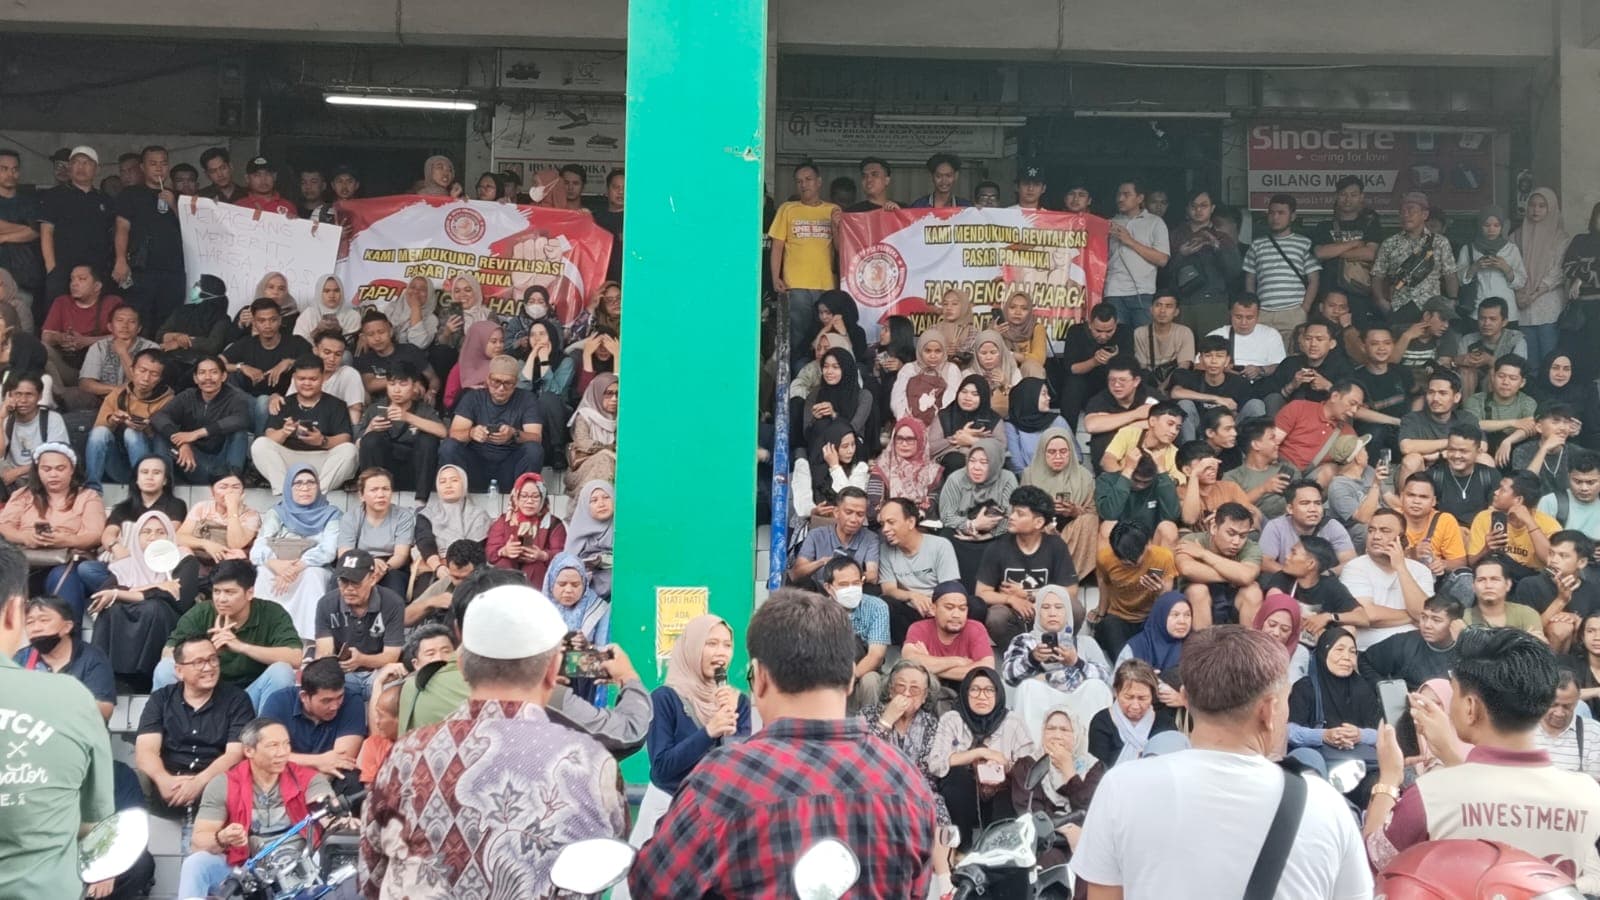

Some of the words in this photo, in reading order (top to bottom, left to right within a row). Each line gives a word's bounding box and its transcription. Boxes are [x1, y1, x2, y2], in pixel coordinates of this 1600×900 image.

[1252, 125, 1395, 150] Sinocare
[1346, 151, 1362, 162] for
[1366, 151, 1388, 162] love
[1262, 174, 1321, 187] GILANG
[1325, 174, 1386, 187] MEIKA
[924, 225, 951, 245] KAMI
[954, 224, 1020, 244] MENDUKUNG
[363, 248, 396, 263] KAMI
[398, 247, 476, 267] MENDUKUNG
[478, 255, 565, 277] REVITALISASI
[963, 248, 996, 267] PASAR
[999, 249, 1051, 270] PRAMUKA
[404, 263, 445, 279] PASAR
[358, 285, 397, 302] TAPI
[1032, 282, 1087, 309] HARGA
[0, 762, 48, 786] ator
[1461, 802, 1589, 834] INVESTMENT
